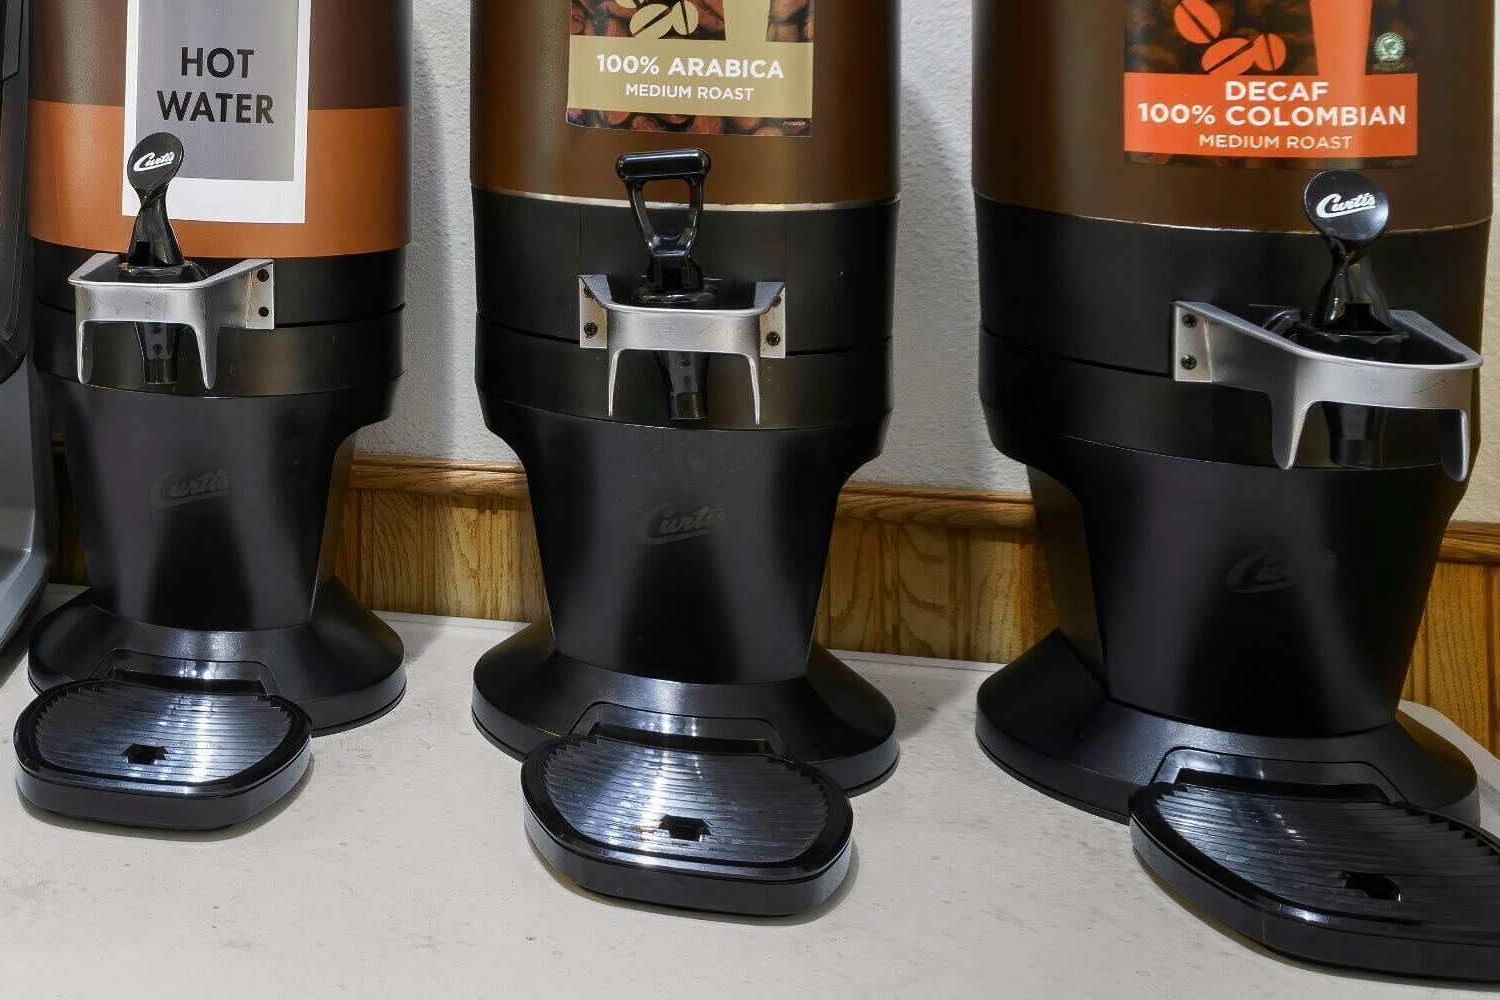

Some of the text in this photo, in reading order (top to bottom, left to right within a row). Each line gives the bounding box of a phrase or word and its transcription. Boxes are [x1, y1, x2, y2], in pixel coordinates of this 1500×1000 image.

[181, 46, 254, 79] HOT
[597, 54, 785, 79] 100% ARABICA
[625, 83, 755, 101] MEDIUM ROAST
[1224, 80, 1329, 102] DECAF
[156, 90, 275, 124] WATER
[1137, 102, 1406, 127] 100% COLOMBIAN
[1199, 134, 1353, 150] MEDIUM ROAST
[133, 150, 175, 172] Curtis
[1315, 191, 1376, 218] Curtis
